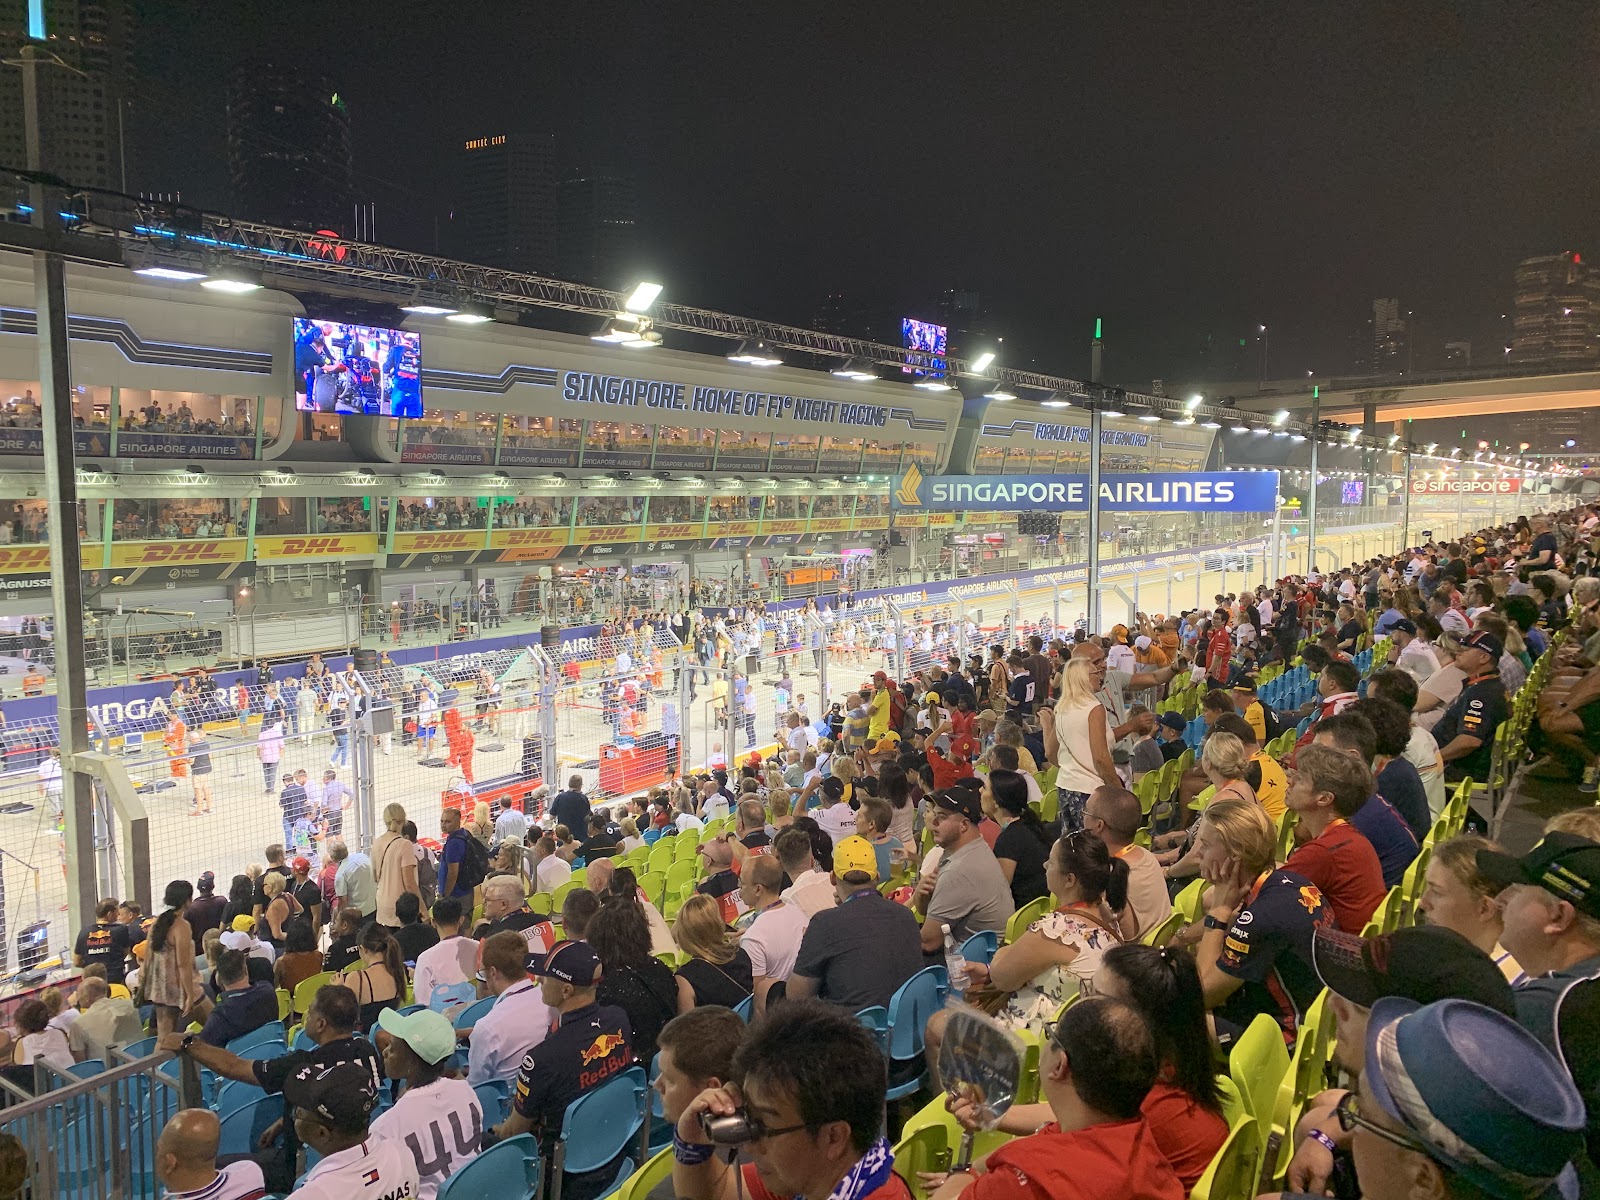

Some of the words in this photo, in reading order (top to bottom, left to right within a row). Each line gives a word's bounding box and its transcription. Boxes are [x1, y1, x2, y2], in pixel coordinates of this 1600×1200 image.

[465, 136, 487, 149] SUNTEC
[492, 135, 506, 145] CITY
[563, 371, 688, 410] SINGAPORE.
[692, 386, 743, 415] HOME
[742, 391, 766, 417] OF
[793, 398, 838, 423] NIGHT
[838, 402, 888, 427] RACING
[1034, 422, 1072, 443] FORMULA
[119, 443, 186, 454] SINGAPORE
[189, 445, 236, 455] AIRLINES
[402, 452, 448, 461] SINGAPORE
[449, 454, 482, 462] AIRLINES
[500, 455, 537, 464] SINGAPORE
[539, 457, 567, 465] AIRLINES
[583, 458, 616, 467] SINGAPORE
[654, 460, 683, 468] SINGAPORE
[684, 461, 705, 469] AIRLINES
[932, 482, 1083, 503] SINGAPORE
[1099, 481, 1234, 503] AIRLINES
[717, 523, 748, 534] DHL
[770, 521, 797, 532] DHL
[817, 519, 843, 530] DHL
[507, 530, 557, 545] DHL
[587, 527, 628, 541] DHL
[656, 525, 692, 538] DHL
[282, 538, 345, 554] DHL
[412, 534, 475, 550] DHL
[141, 543, 223, 562] DHL
[0, 578, 52, 590] AGNUSSE
[948, 582, 985, 595] SINGAPORE
[986, 579, 1014, 590] AIRLINES
[86, 938, 100, 946] Red
[101, 937, 112, 945] Bull
[88, 947, 104, 955] Mobil
[580, 1060, 608, 1090] Red
[608, 1045, 632, 1073] Bull
[404, 1102, 483, 1180] 44
